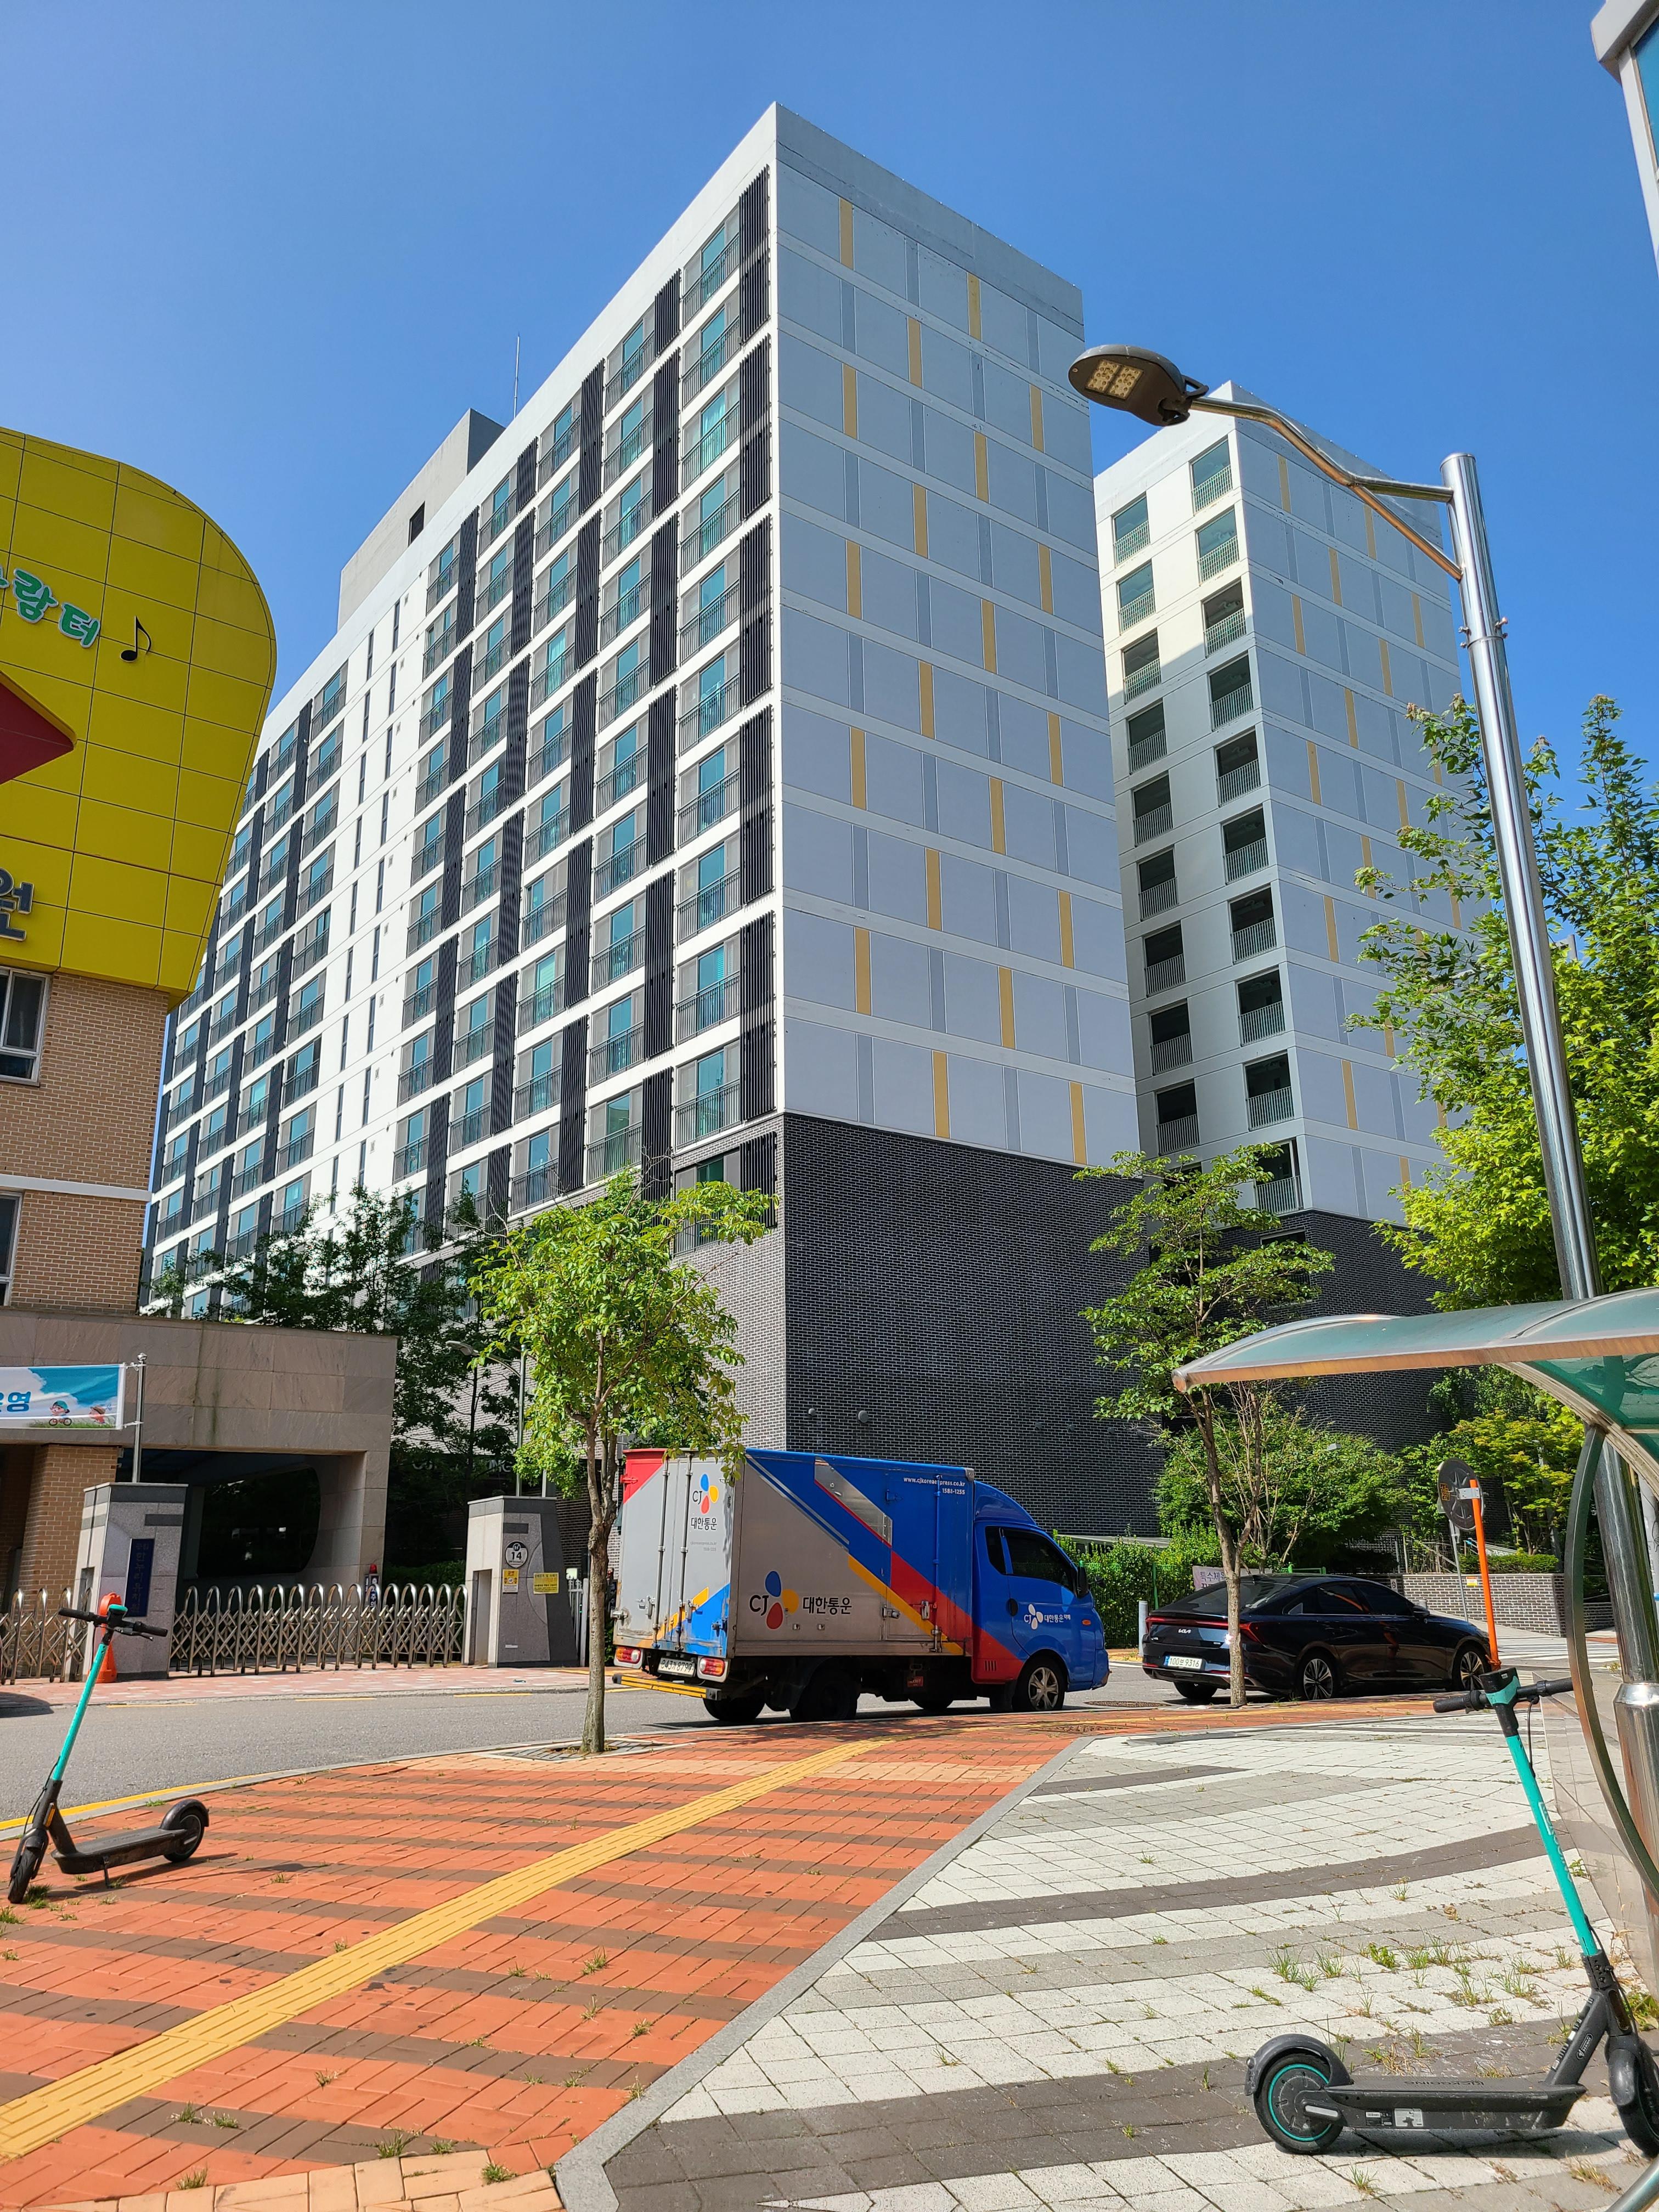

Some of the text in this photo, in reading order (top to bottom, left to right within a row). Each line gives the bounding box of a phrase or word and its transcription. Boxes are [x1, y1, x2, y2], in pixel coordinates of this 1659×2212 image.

[0, 1391, 31, 1412] 영
[904, 1477, 966, 1487] www.cjkoreaepress.co.kr
[692, 1491, 703, 1505] CJ
[691, 1517, 718, 1531] 대한통운
[511, 1551, 522, 1560] 14
[749, 1595, 769, 1616] CJ
[803, 1596, 852, 1615] 대한통운
[1024, 1615, 1031, 1624] CJ
